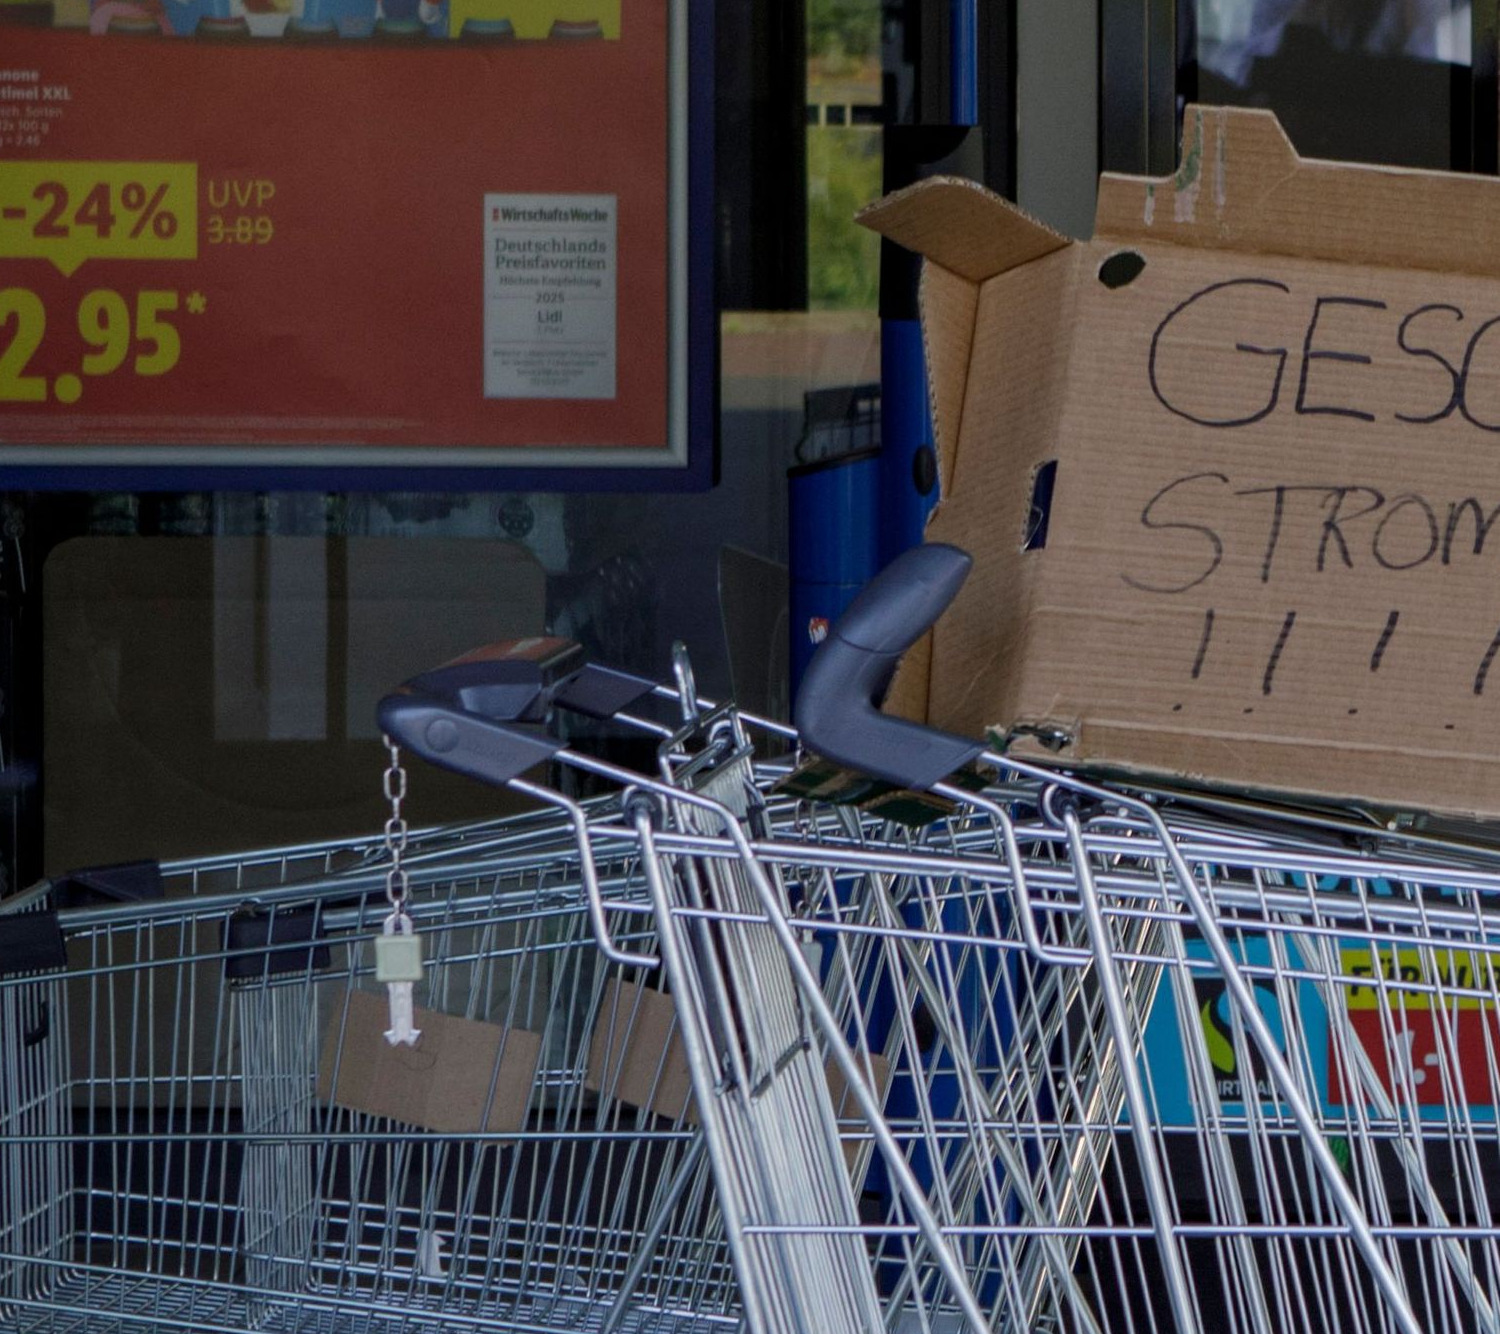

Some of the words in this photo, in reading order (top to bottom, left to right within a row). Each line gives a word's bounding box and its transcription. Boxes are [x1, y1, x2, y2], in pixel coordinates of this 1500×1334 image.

[42, 87, 72, 101] XXL
[208, 178, 277, 209] UVP
[2, 180, 179, 241] -24%
[207, 213, 275, 245] 3.89
[495, 237, 607, 254] Deutschlands
[495, 255, 606, 271] Preisfavoriten
[536, 292, 565, 304] 2025
[537, 310, 563, 324] Lidl
